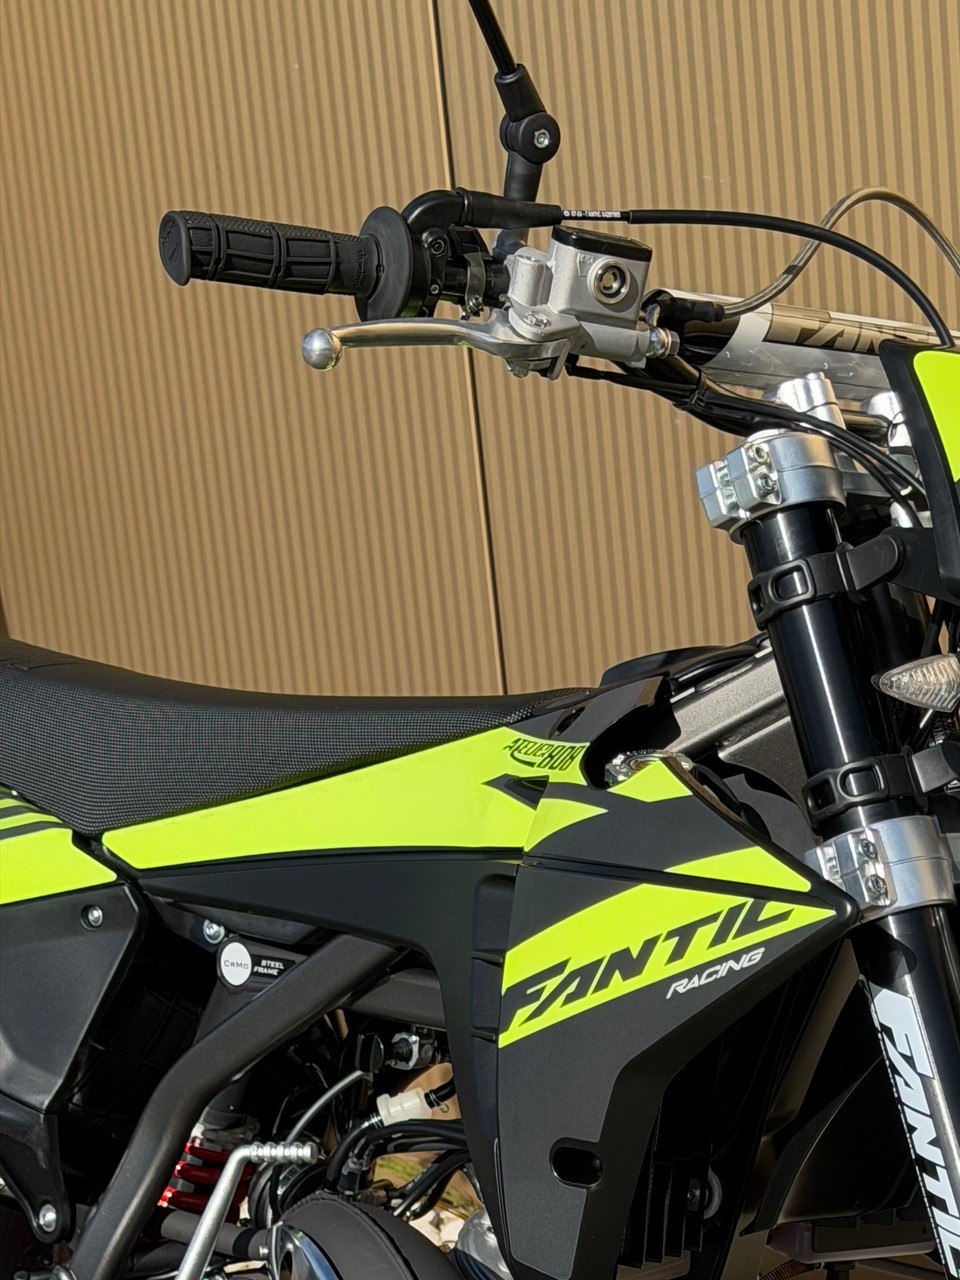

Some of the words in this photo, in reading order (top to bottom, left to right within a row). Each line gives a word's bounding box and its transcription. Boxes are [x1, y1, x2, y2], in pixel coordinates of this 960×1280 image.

[253, 966, 279, 976] FRAME
[261, 959, 285, 970] STEEL
[501, 899, 795, 1032] FANTIC
[666, 947, 765, 999] RACING
